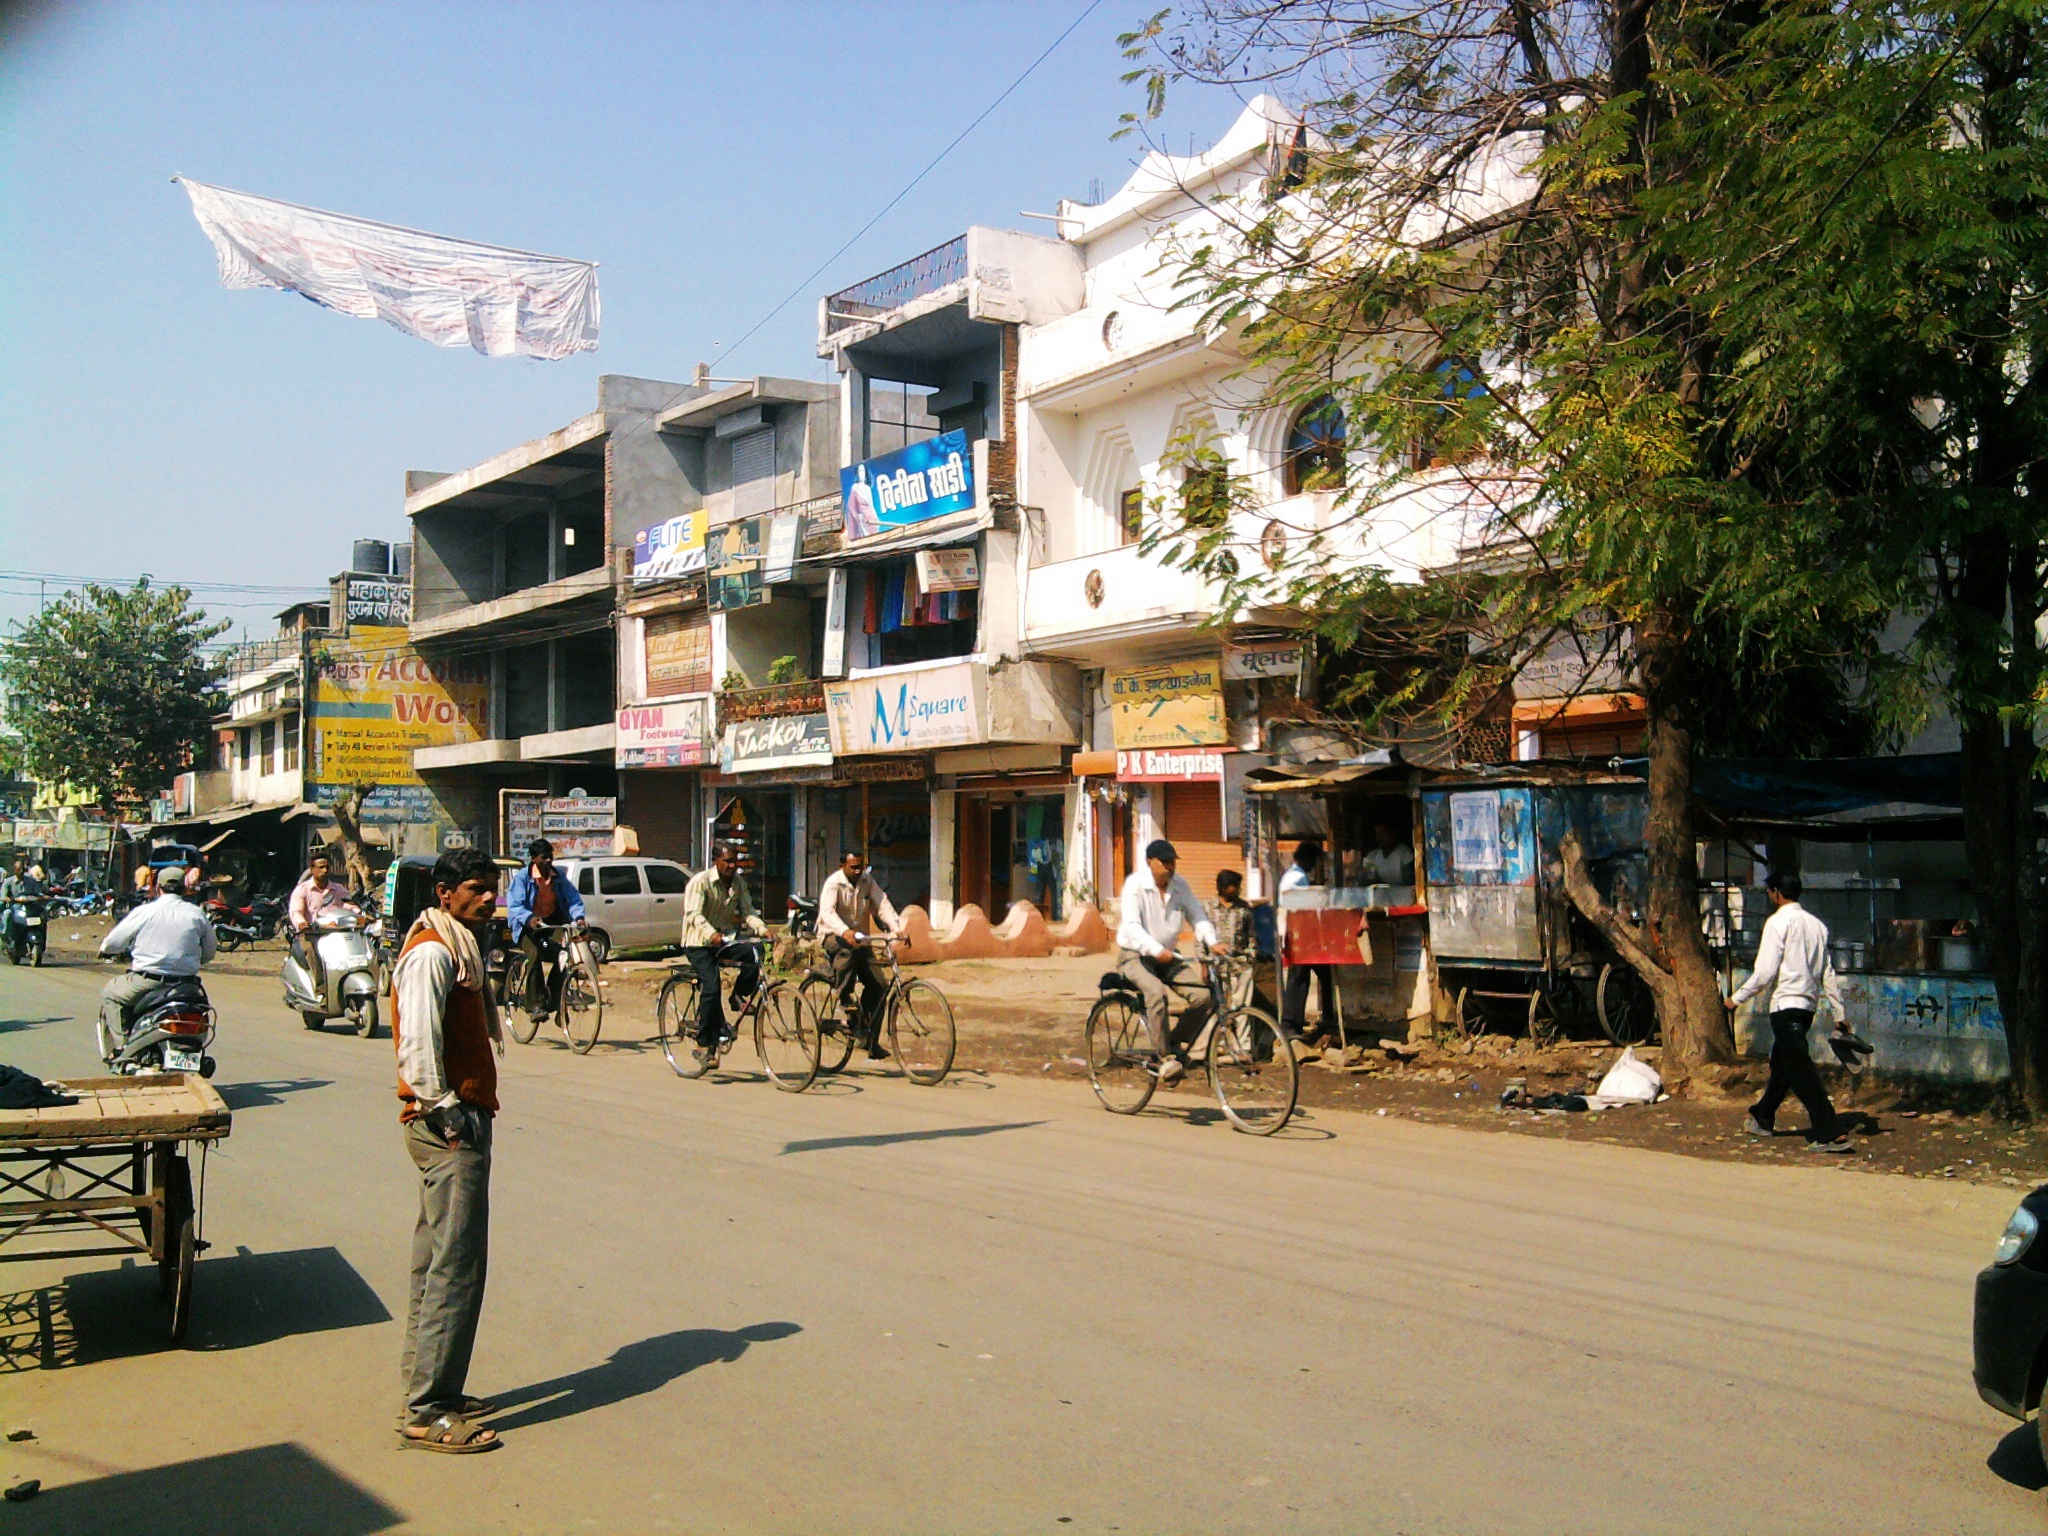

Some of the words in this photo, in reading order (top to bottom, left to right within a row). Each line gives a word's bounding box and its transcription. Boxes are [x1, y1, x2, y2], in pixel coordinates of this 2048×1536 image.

[876, 468, 929, 514] विनीता
[927, 452, 968, 502] साड़ी
[620, 707, 664, 730] GYAN
[871, 683, 911, 744] M
[910, 695, 968, 723] Square
[640, 728, 686, 740] Footwear
[1117, 751, 1128, 775] P
[1131, 750, 1143, 775] K
[1146, 748, 1224, 780] Enterprise
